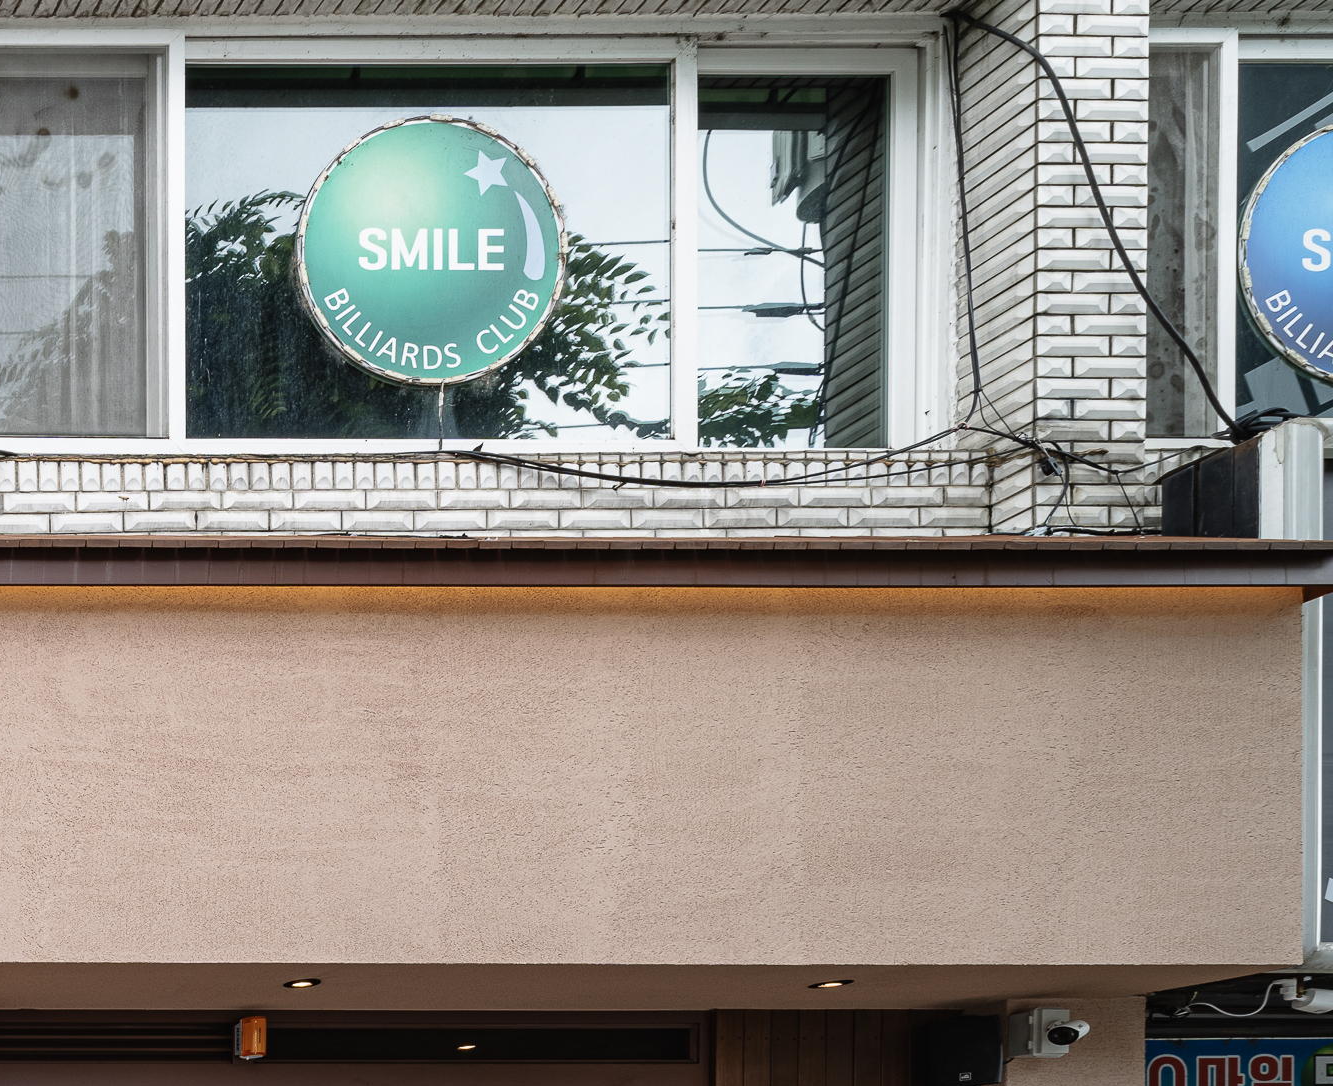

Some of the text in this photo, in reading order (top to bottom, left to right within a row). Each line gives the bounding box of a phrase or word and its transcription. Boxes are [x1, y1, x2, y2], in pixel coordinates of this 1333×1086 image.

[358, 228, 505, 272] SMILE
[324, 287, 539, 370] BILLIARDS CLUB
